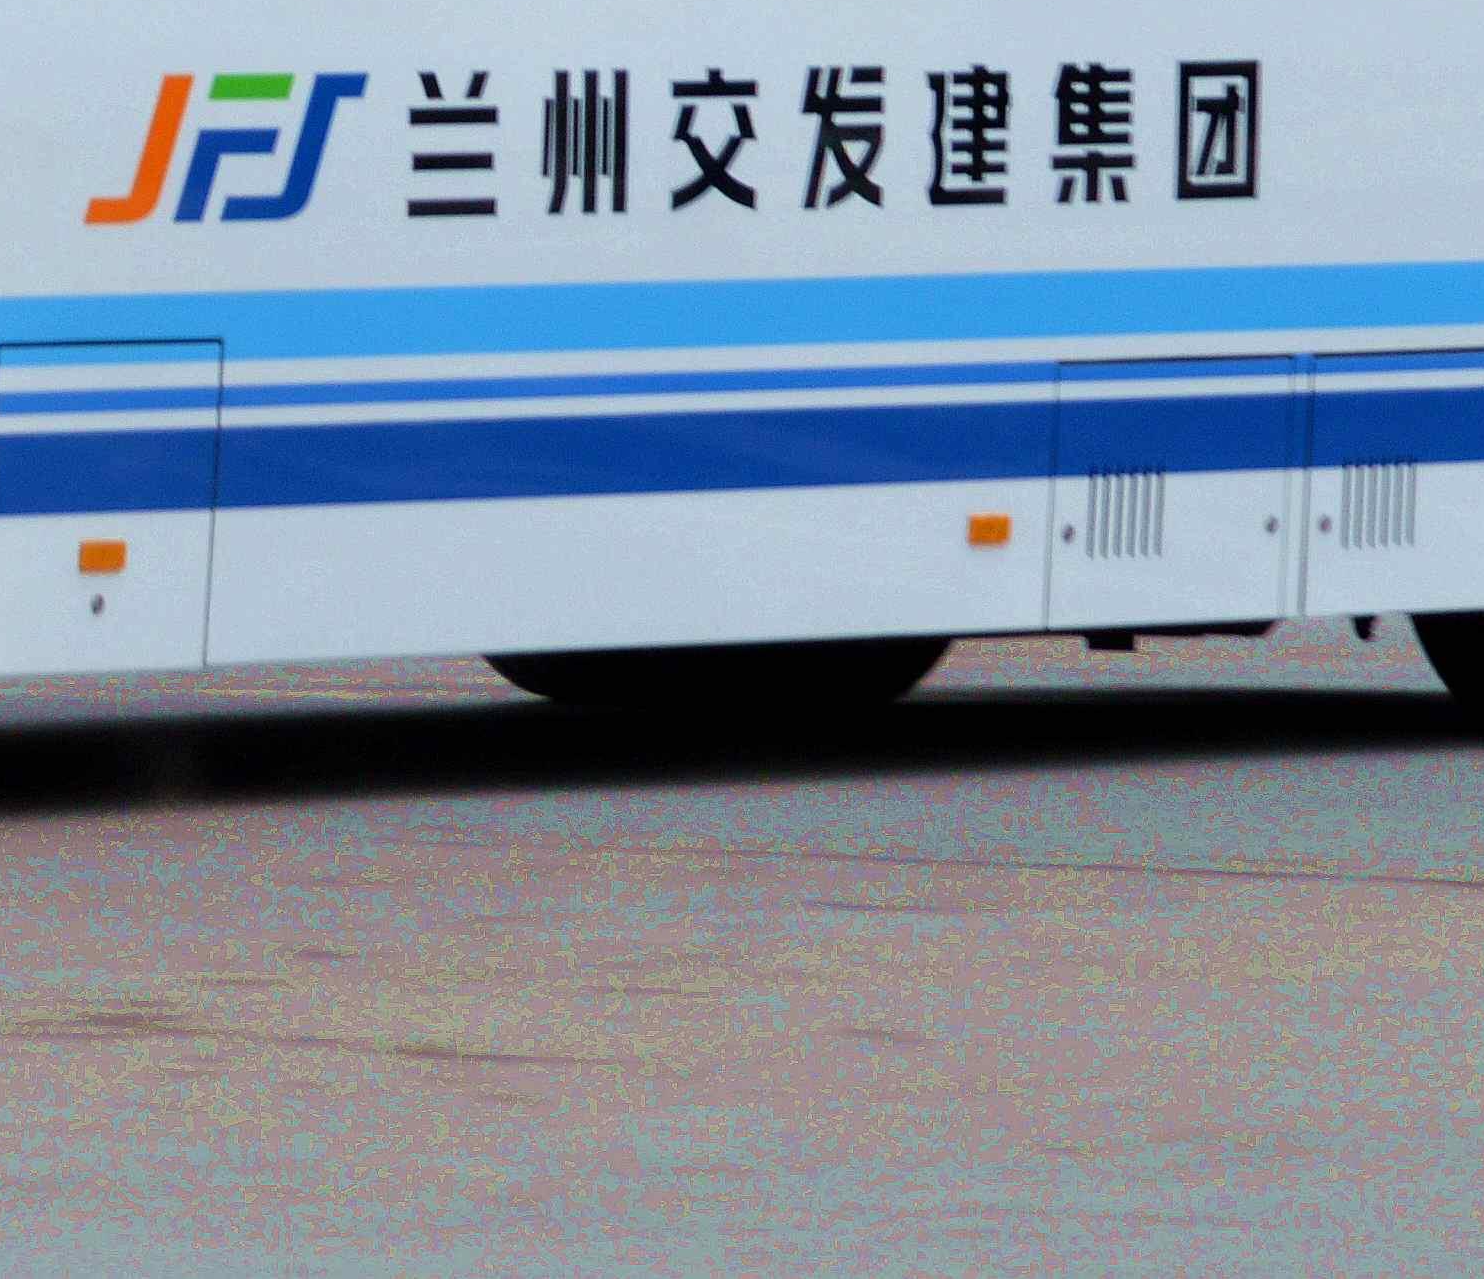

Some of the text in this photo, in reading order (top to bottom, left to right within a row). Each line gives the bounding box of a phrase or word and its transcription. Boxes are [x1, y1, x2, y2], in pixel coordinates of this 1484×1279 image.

[406, 59, 1262, 217] 兰州交发建集团
